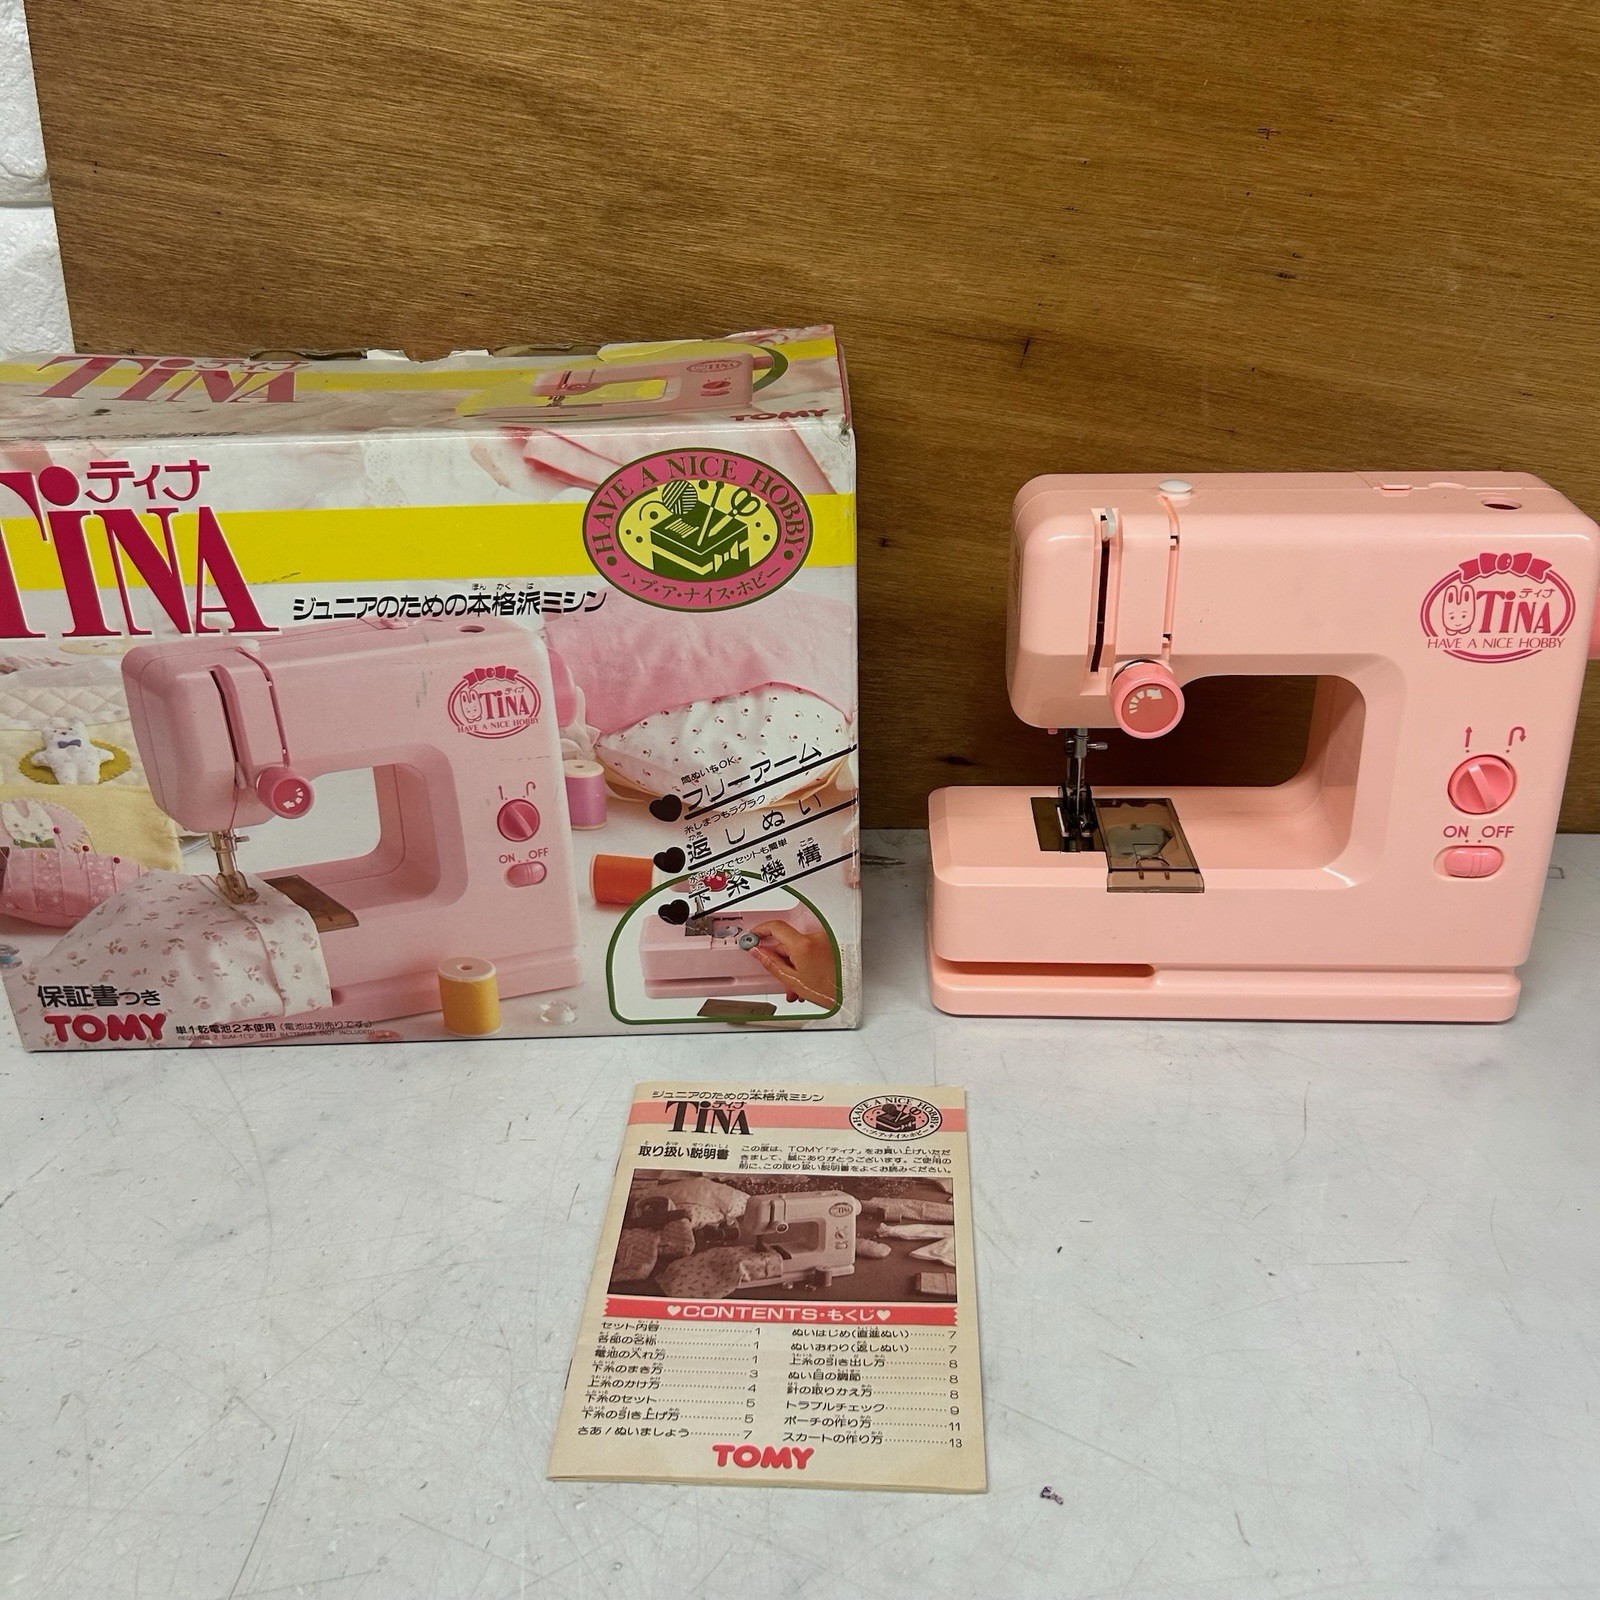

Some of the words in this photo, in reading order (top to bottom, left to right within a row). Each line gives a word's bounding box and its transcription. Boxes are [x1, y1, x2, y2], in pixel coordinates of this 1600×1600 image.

[730, 408, 831, 421] TOMY
[85, 459, 210, 503] ティナ
[592, 478, 635, 555] HAVE
[638, 465, 660, 488] A
[665, 455, 738, 480] NICE
[747, 468, 806, 553] HOBBY
[1519, 588, 1555, 599] ティナ
[293, 590, 607, 621] ジュニアのための本格派ミシン
[1427, 637, 1462, 649] HAVE
[1467, 638, 1478, 649] A
[1482, 638, 1514, 649] NICE
[1518, 638, 1566, 649] HOBBY
[457, 724, 479, 734] HAVE
[490, 721, 511, 729] NICE
[513, 717, 540, 727] HOBBY
[682, 743, 822, 811] フリーアーム
[1443, 825, 1469, 838] ON
[1481, 825, 1515, 838] OFF
[498, 853, 516, 865] ON
[528, 847, 549, 860] OFF
[37, 984, 161, 1008] 保証書つき
[44, 1012, 167, 1043] TOMY
[652, 1091, 825, 1102] ジュニアのための本格派ミシン
[852, 1102, 872, 1123] HAVE
[885, 1097, 914, 1105] NICE
[917, 1102, 939, 1126] HOBBY
[638, 1146, 729, 1160] 取り扱い説明書
[601, 1322, 660, 1332] セット内容
[755, 1327, 761, 1335] 1
[948, 1331, 957, 1339] 7
[598, 1335, 657, 1346] 各部の名称
[754, 1341, 759, 1349] 1
[595, 1349, 666, 1360] 電池の入れ方
[752, 1355, 758, 1364] 1
[948, 1345, 957, 1354] 7
[789, 1357, 885, 1367] 上糸の引き出し方
[949, 1360, 958, 1369] 8
[592, 1364, 663, 1375] 下糸のまき方
[749, 1370, 759, 1378] 3
[587, 1378, 661, 1389] 上糸のかけ方
[747, 1384, 757, 1393] 4
[949, 1375, 959, 1384] 8
[786, 1386, 872, 1397] 針の取りかえ方
[949, 1390, 959, 1399] 8
[586, 1394, 657, 1404] 下糸のセット
[746, 1398, 756, 1408] 5
[786, 1400, 885, 1412] トラブルチェック
[950, 1405, 960, 1415] 9
[581, 1409, 680, 1421] 下糸の引き上げ方
[744, 1414, 754, 1423] 5
[784, 1416, 872, 1428] ポーチの作り方
[949, 1421, 961, 1431] 11
[743, 1430, 753, 1440] 7
[782, 1432, 883, 1444] スカートの作り方
[949, 1439, 963, 1448] 13
[711, 1444, 815, 1470] TOMY
